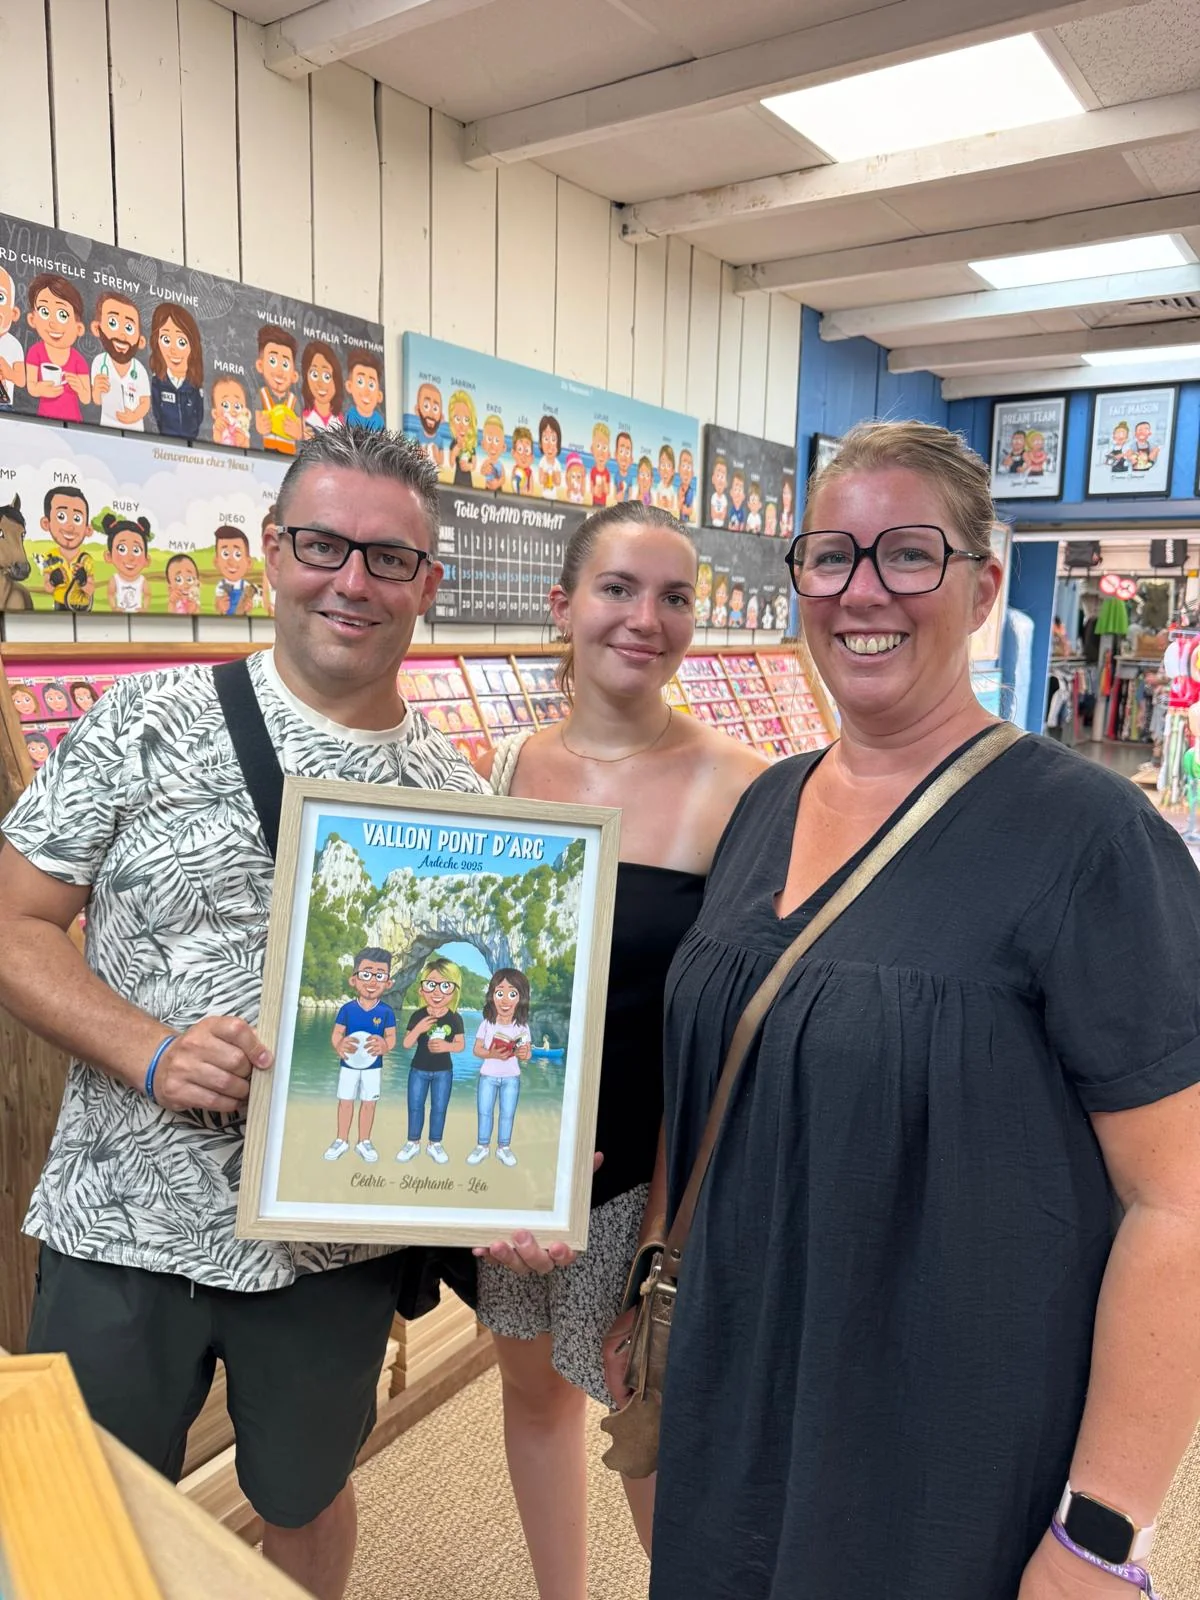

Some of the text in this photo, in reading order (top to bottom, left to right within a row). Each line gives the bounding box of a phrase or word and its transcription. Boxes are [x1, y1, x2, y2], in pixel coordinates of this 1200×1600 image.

[20, 253, 86, 279] CHRISTELLE
[93, 271, 140, 294] JEREMY
[149, 284, 199, 307] LUDIVINE
[257, 310, 296, 330] WILLIAM
[303, 327, 340, 344] NATALIA
[342, 334, 384, 353] JONATHAN
[213, 359, 245, 376] MARIA
[1002, 409, 1056, 425] DREAM TEAM
[1109, 402, 1159, 416] FAIT MAISON
[53, 471, 77, 484] MAX
[112, 500, 139, 512] RUBY
[218, 512, 246, 524] DIEGO
[454, 500, 567, 531] Toile GRAND FORMAT
[168, 540, 196, 552] MAYA
[464, 534, 468, 549] 1
[476, 535, 481, 551] 2
[488, 536, 493, 551] 3
[500, 538, 505, 553] 4
[512, 539, 517, 554] 5
[523, 541, 529, 556] 6
[534, 541, 539, 556] 7
[362, 822, 545, 861] VALLON PONT D'ARC
[417, 855, 484, 872] Ardèche 2025
[350, 1172, 387, 1188] Cédric
[399, 1174, 455, 1195] Stéphanie
[467, 1177, 488, 1194] Léa
